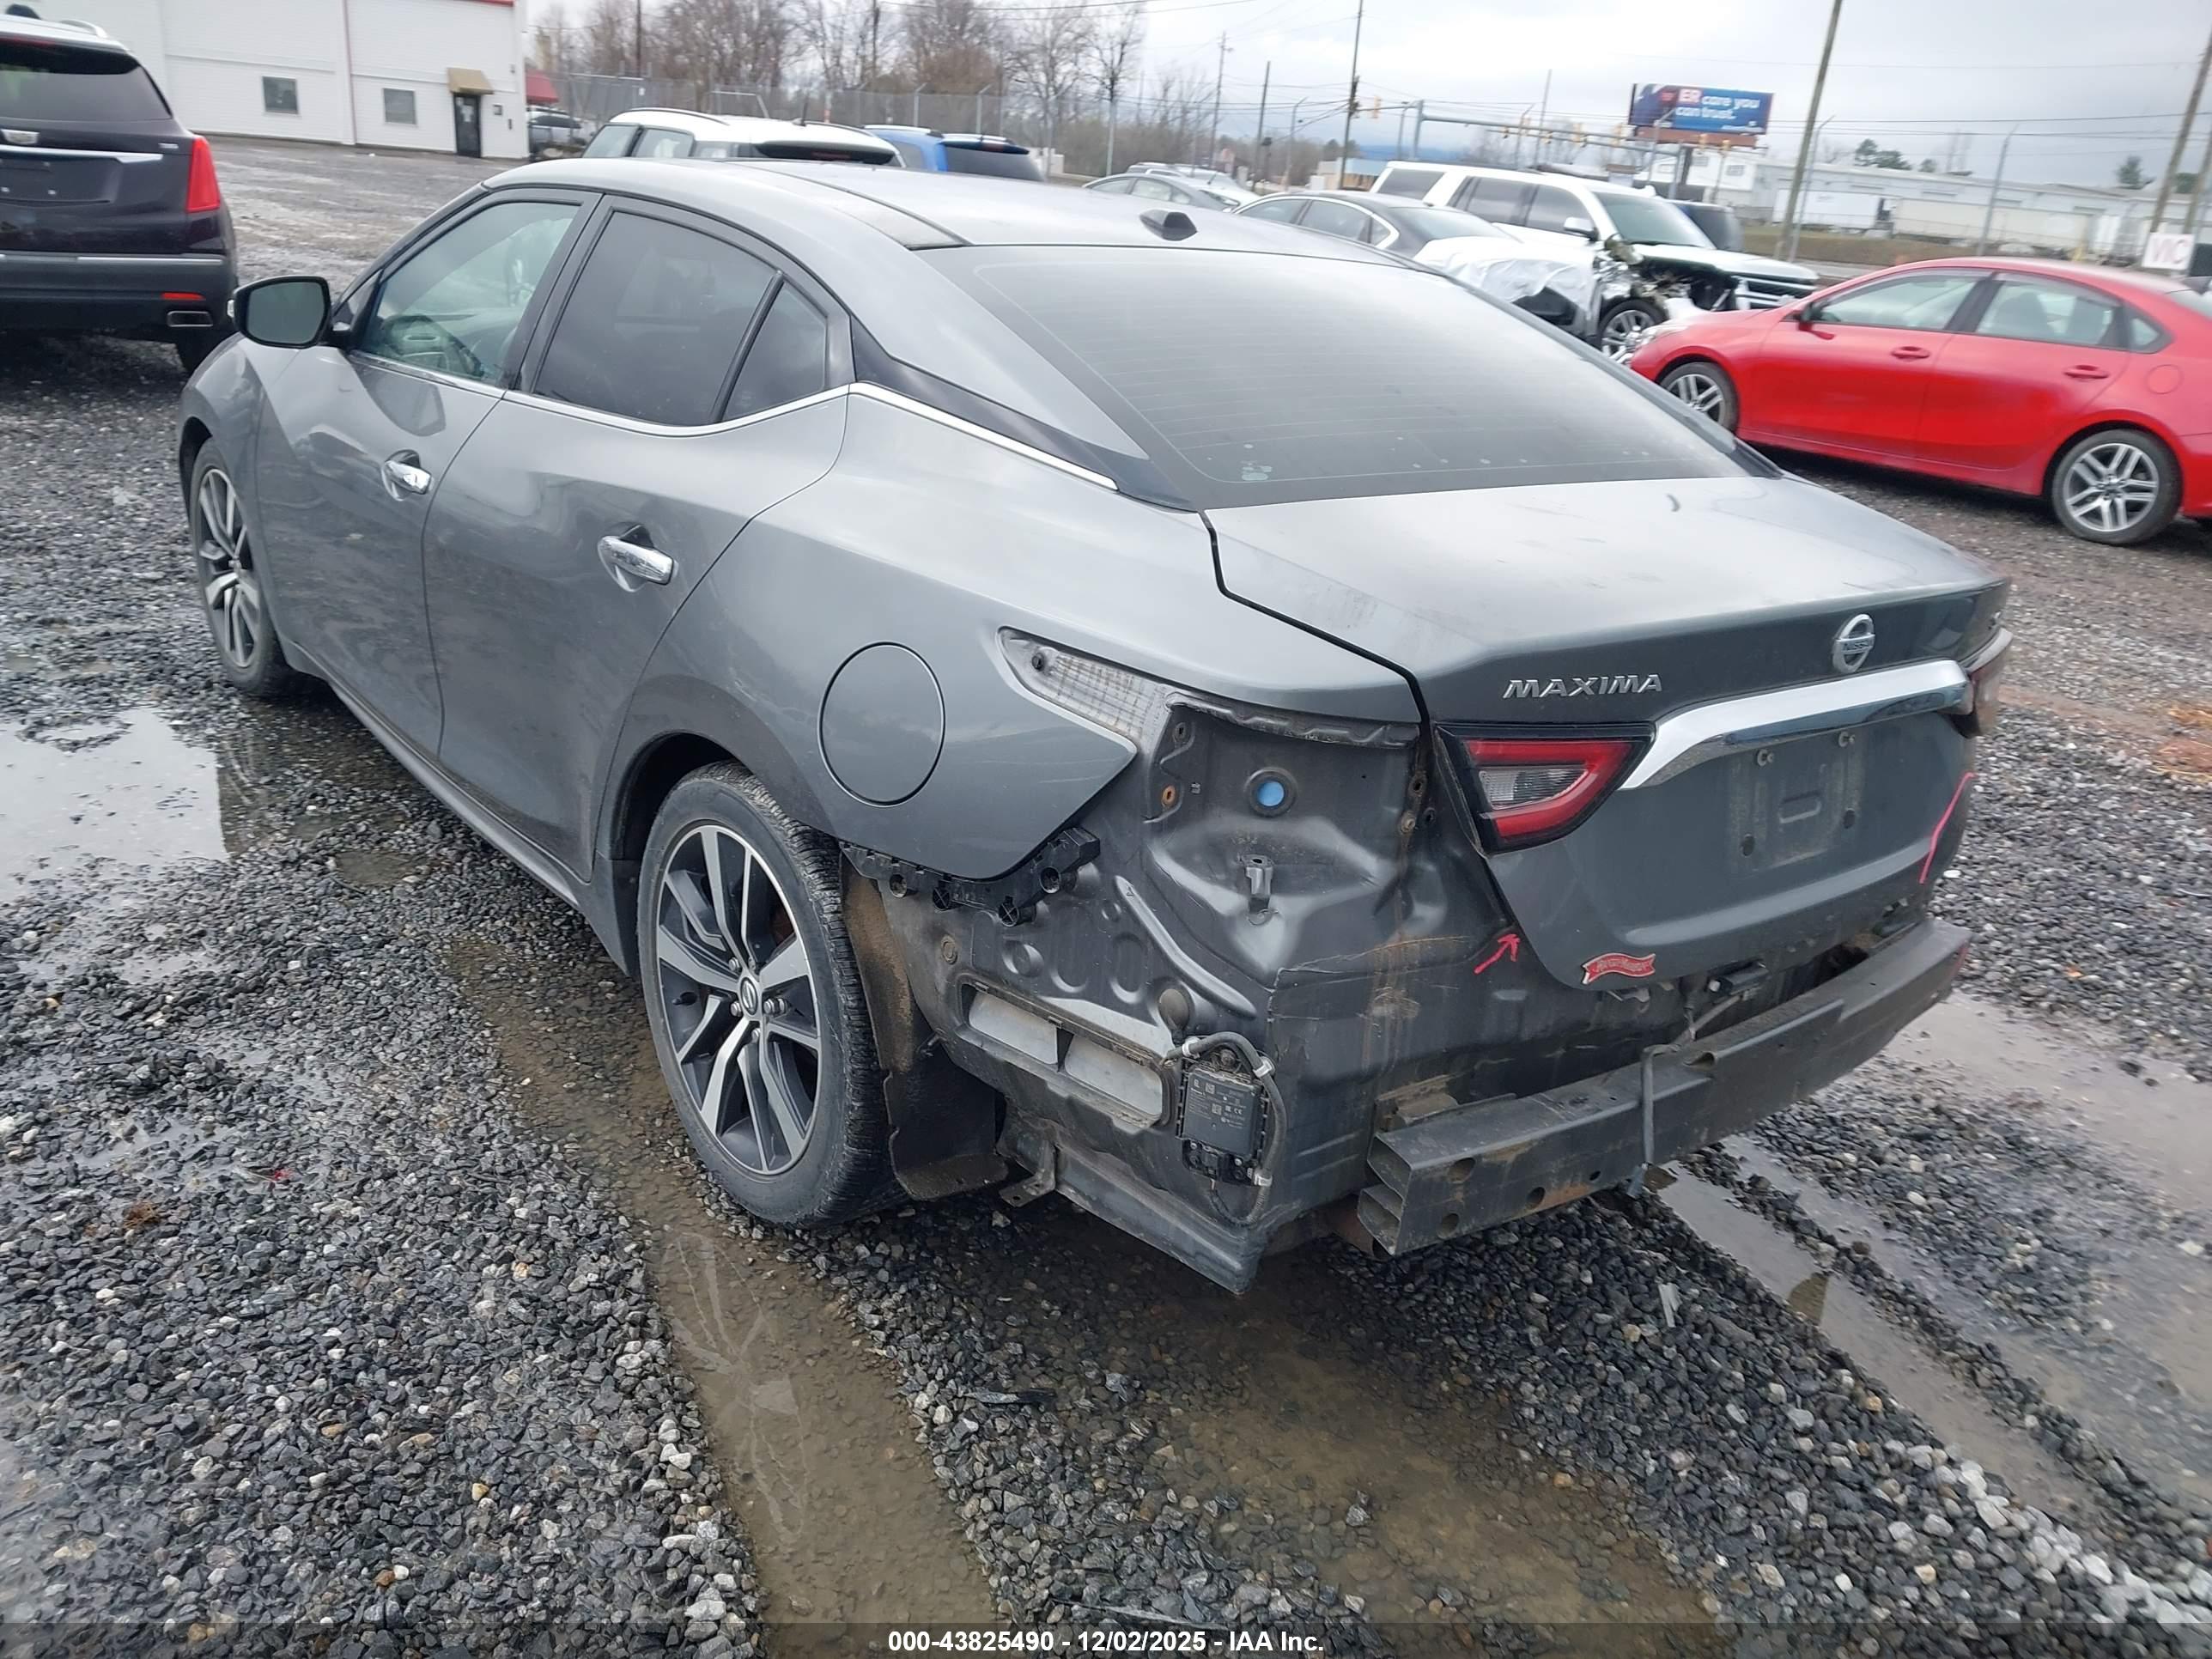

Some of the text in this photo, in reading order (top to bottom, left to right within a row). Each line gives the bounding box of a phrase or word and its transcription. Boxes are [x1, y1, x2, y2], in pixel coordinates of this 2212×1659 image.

[1679, 88, 1701, 103] ER
[1702, 95, 1731, 106] care
[1733, 98, 1760, 110] you
[1675, 106, 1700, 117] can
[1503, 674, 1663, 699] MAXIMA
